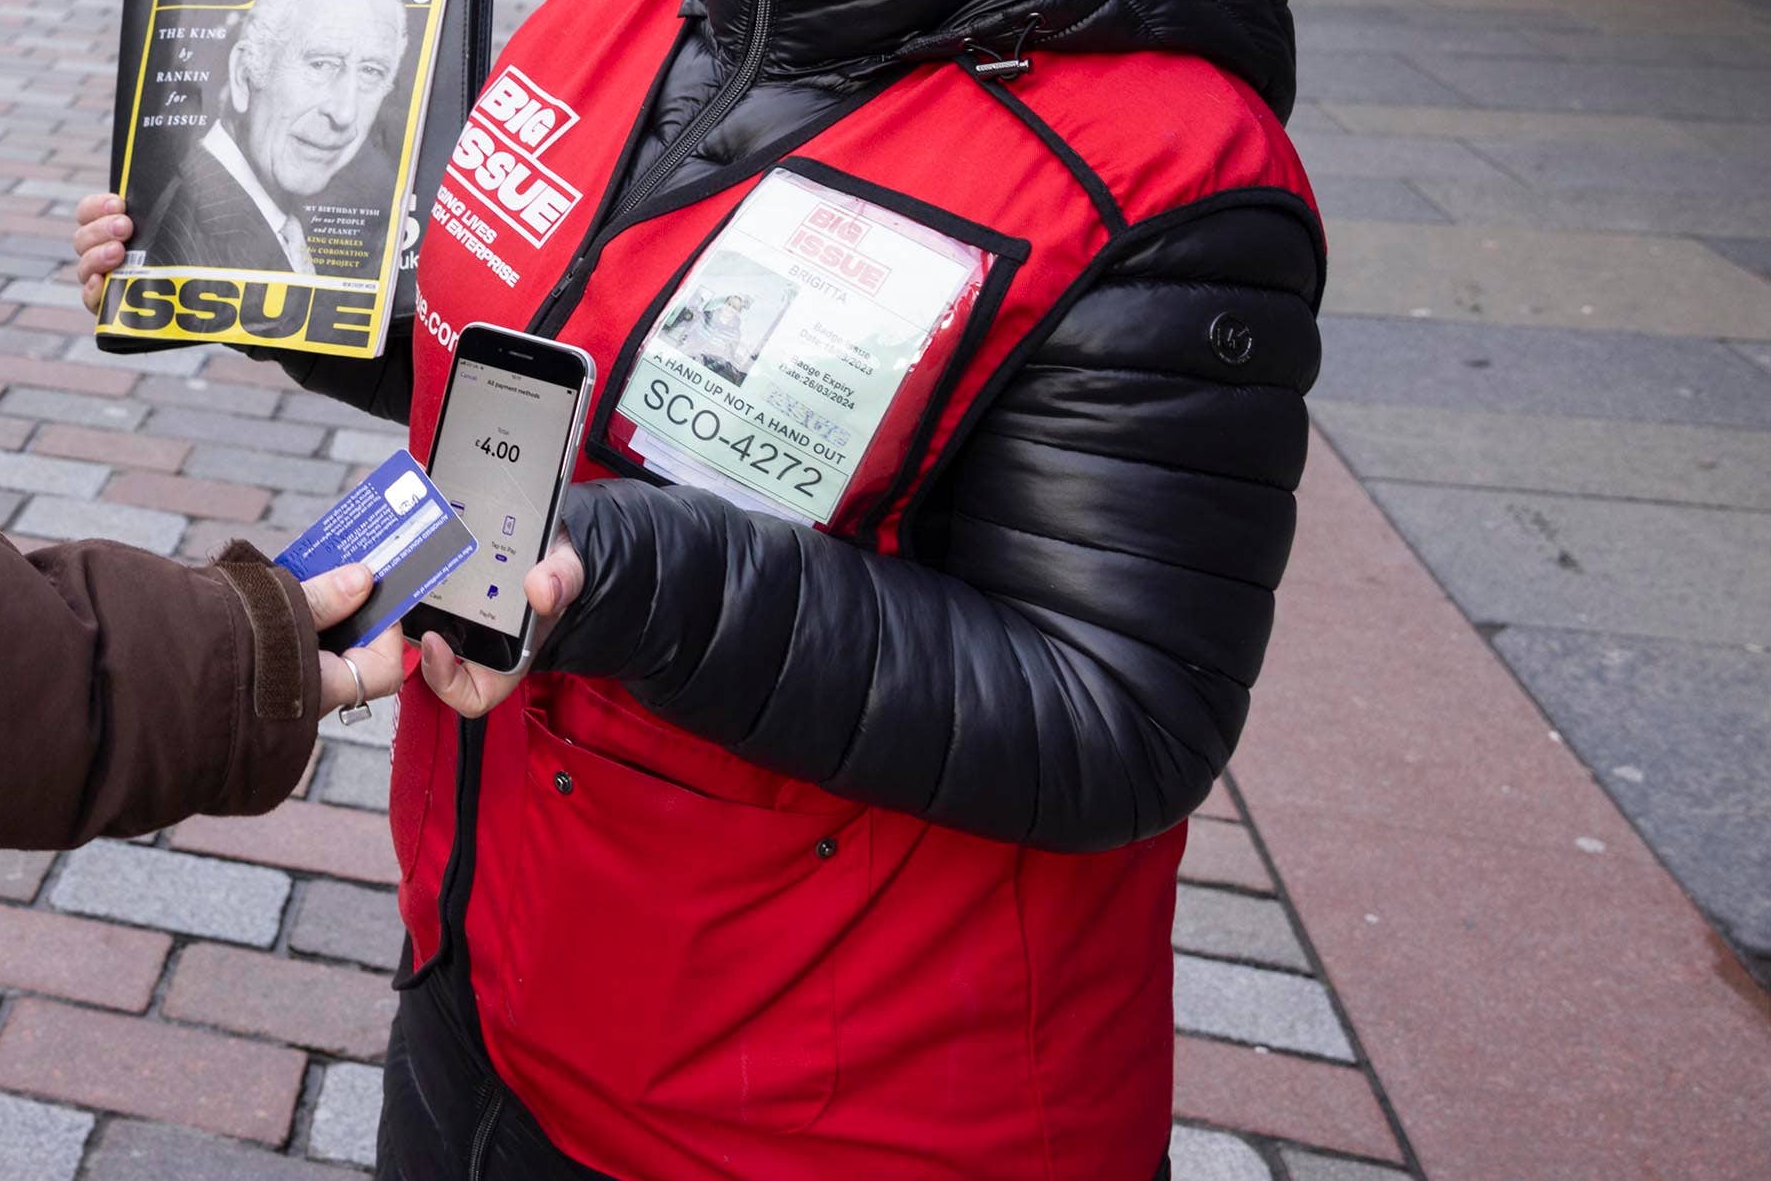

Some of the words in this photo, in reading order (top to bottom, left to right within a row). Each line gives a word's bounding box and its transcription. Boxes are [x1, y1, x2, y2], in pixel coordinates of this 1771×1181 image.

[159, 28, 185, 39] THE
[190, 27, 227, 39] KING
[178, 47, 193, 62] by
[156, 71, 210, 82] RANKIN
[165, 90, 187, 106] for
[143, 115, 163, 127] BIG
[168, 115, 208, 126] ISSUE
[479, 75, 556, 148] BIG
[451, 121, 572, 235] SSUE
[317, 205, 358, 215] BIRTHDAY
[359, 208, 380, 216] WISH
[336, 218, 366, 226] PEOPLE
[461, 210, 498, 244] LIVES
[808, 207, 863, 245] BIG
[307, 235, 327, 244] KING
[328, 238, 364, 247] CHARLES
[317, 248, 370, 258] CORONATION
[445, 218, 521, 289] ENTERPRISE
[790, 230, 885, 290] ISSUE
[326, 258, 361, 268] PROJECT
[788, 264, 847, 304] BRIGITTA
[98, 277, 377, 348] ISSUE
[495, 381, 518, 394] payment
[518, 386, 541, 400] methods
[822, 372, 855, 398] Expiry
[665, 359, 703, 386] HAND
[704, 379, 723, 397] UP
[725, 393, 755, 416] NOT
[754, 412, 765, 425] A
[768, 418, 811, 449] HAND
[813, 442, 846, 466] OUT
[643, 378, 823, 499] SCO-4272
[491, 541, 501, 551] Tap
